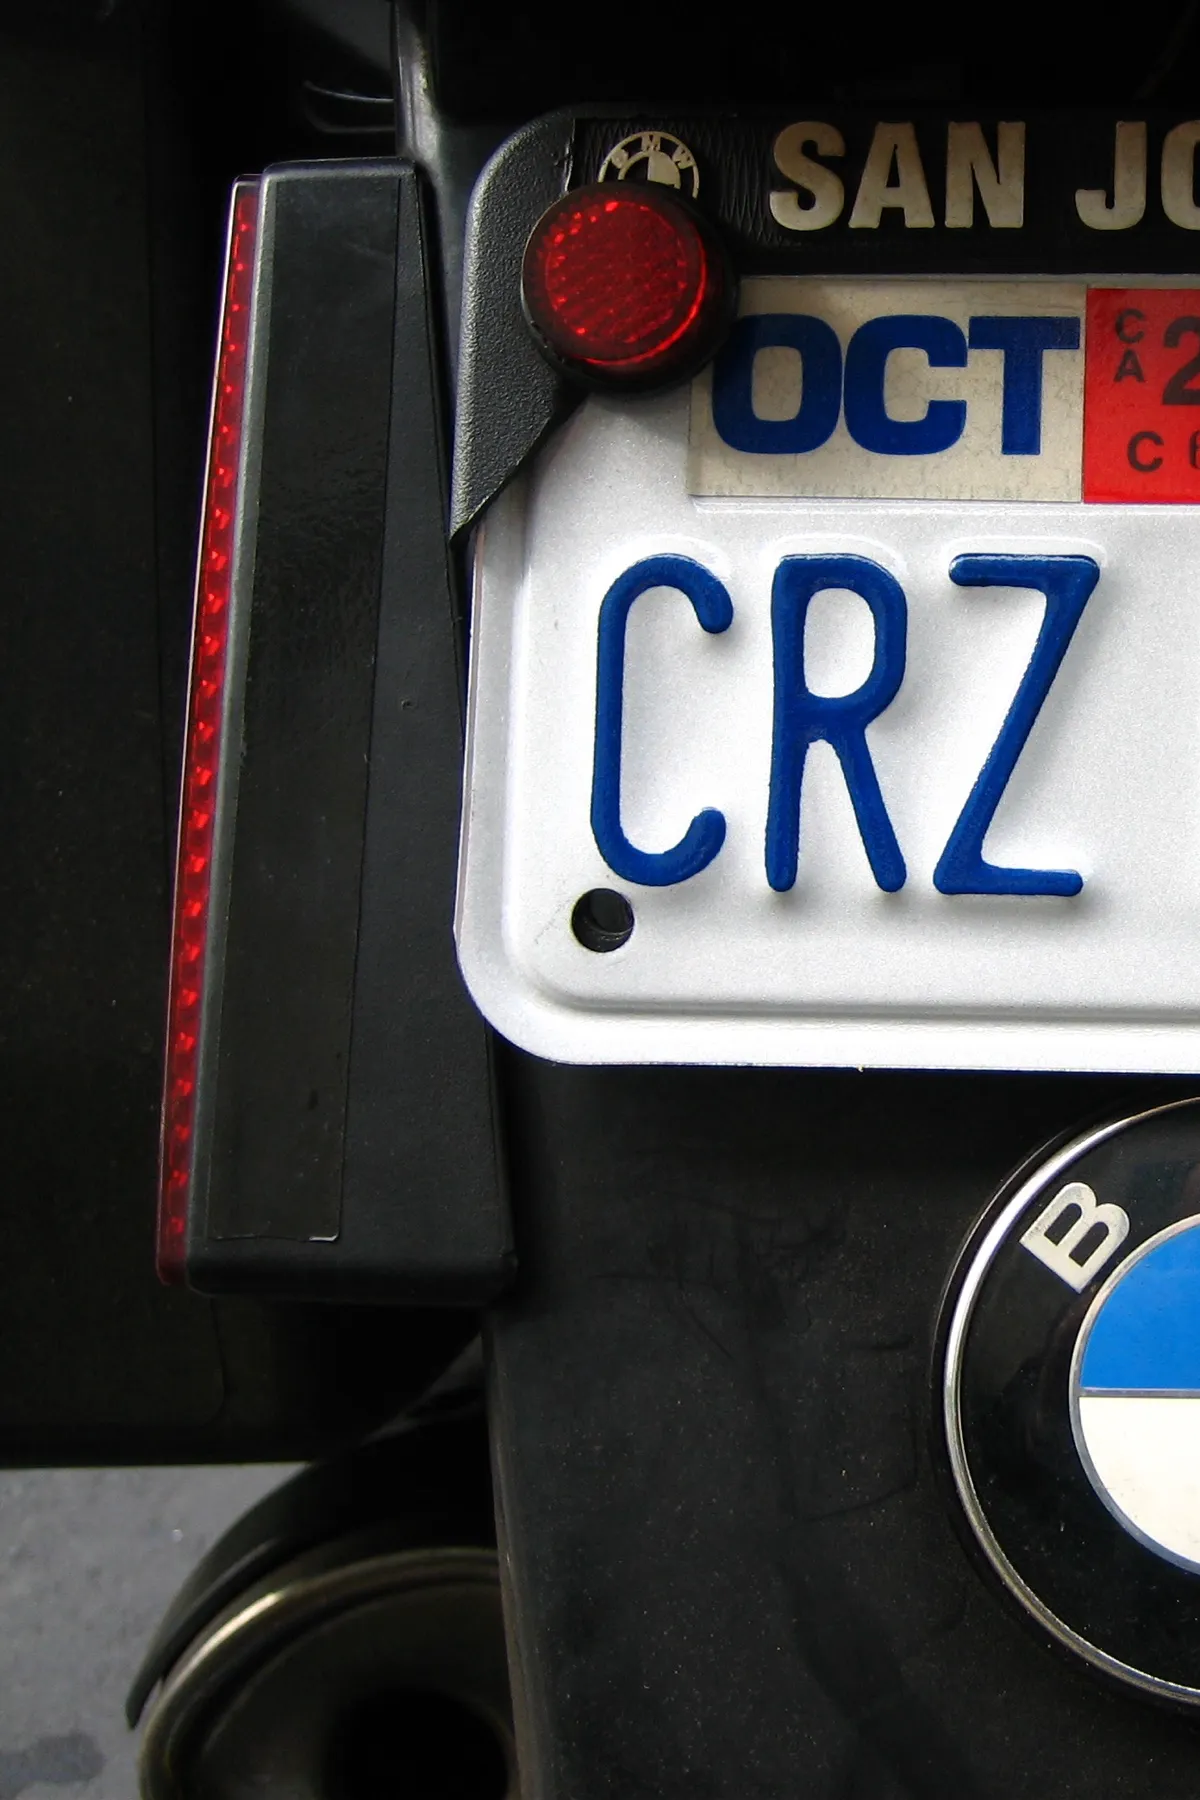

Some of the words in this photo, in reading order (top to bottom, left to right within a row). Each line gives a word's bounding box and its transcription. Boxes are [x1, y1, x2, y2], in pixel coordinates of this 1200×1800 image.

[769, 121, 1026, 231] SAN
[711, 313, 1081, 456] OCT
[1126, 430, 1165, 472] C
[590, 553, 1100, 896] CRZ
